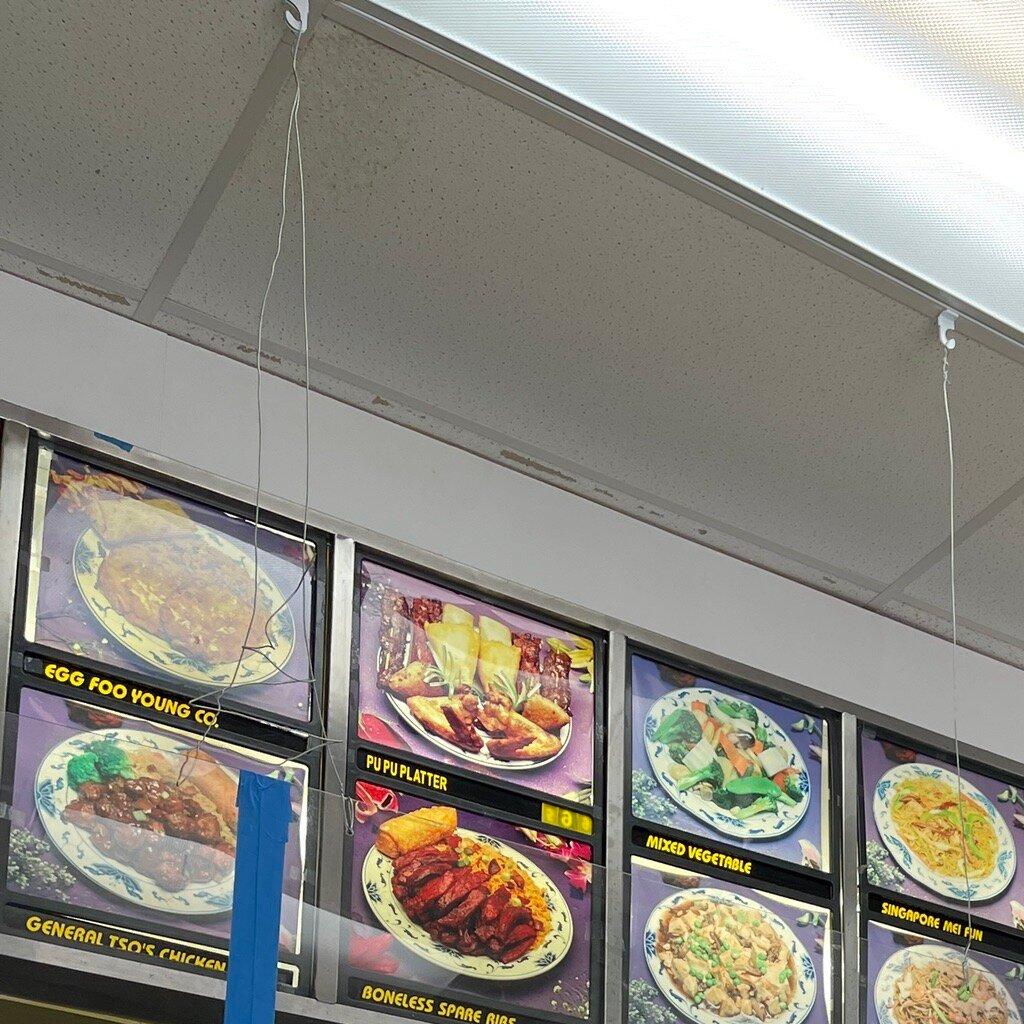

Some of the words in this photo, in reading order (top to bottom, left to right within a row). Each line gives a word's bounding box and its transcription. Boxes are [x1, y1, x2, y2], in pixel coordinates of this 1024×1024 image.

[44, 664, 85, 688] EGG
[88, 677, 128, 700] FOO
[131, 688, 191, 720] YOUNG
[195, 709, 219, 728] CO.
[366, 754, 381, 772] PU
[383, 758, 397, 776] PU
[400, 762, 447, 792] PLATTER
[646, 835, 686, 856] MIXED
[688, 846, 752, 874] VEGETABLE
[26, 915, 104, 946] GENERAL
[108, 934, 156, 958] TSO'S
[881, 902, 940, 928] SINGAPORE
[942, 920, 961, 936] MEI
[964, 927, 983, 942] FUN
[362, 986, 434, 1013] BONELESS
[438, 1002, 482, 1024] SPARE
